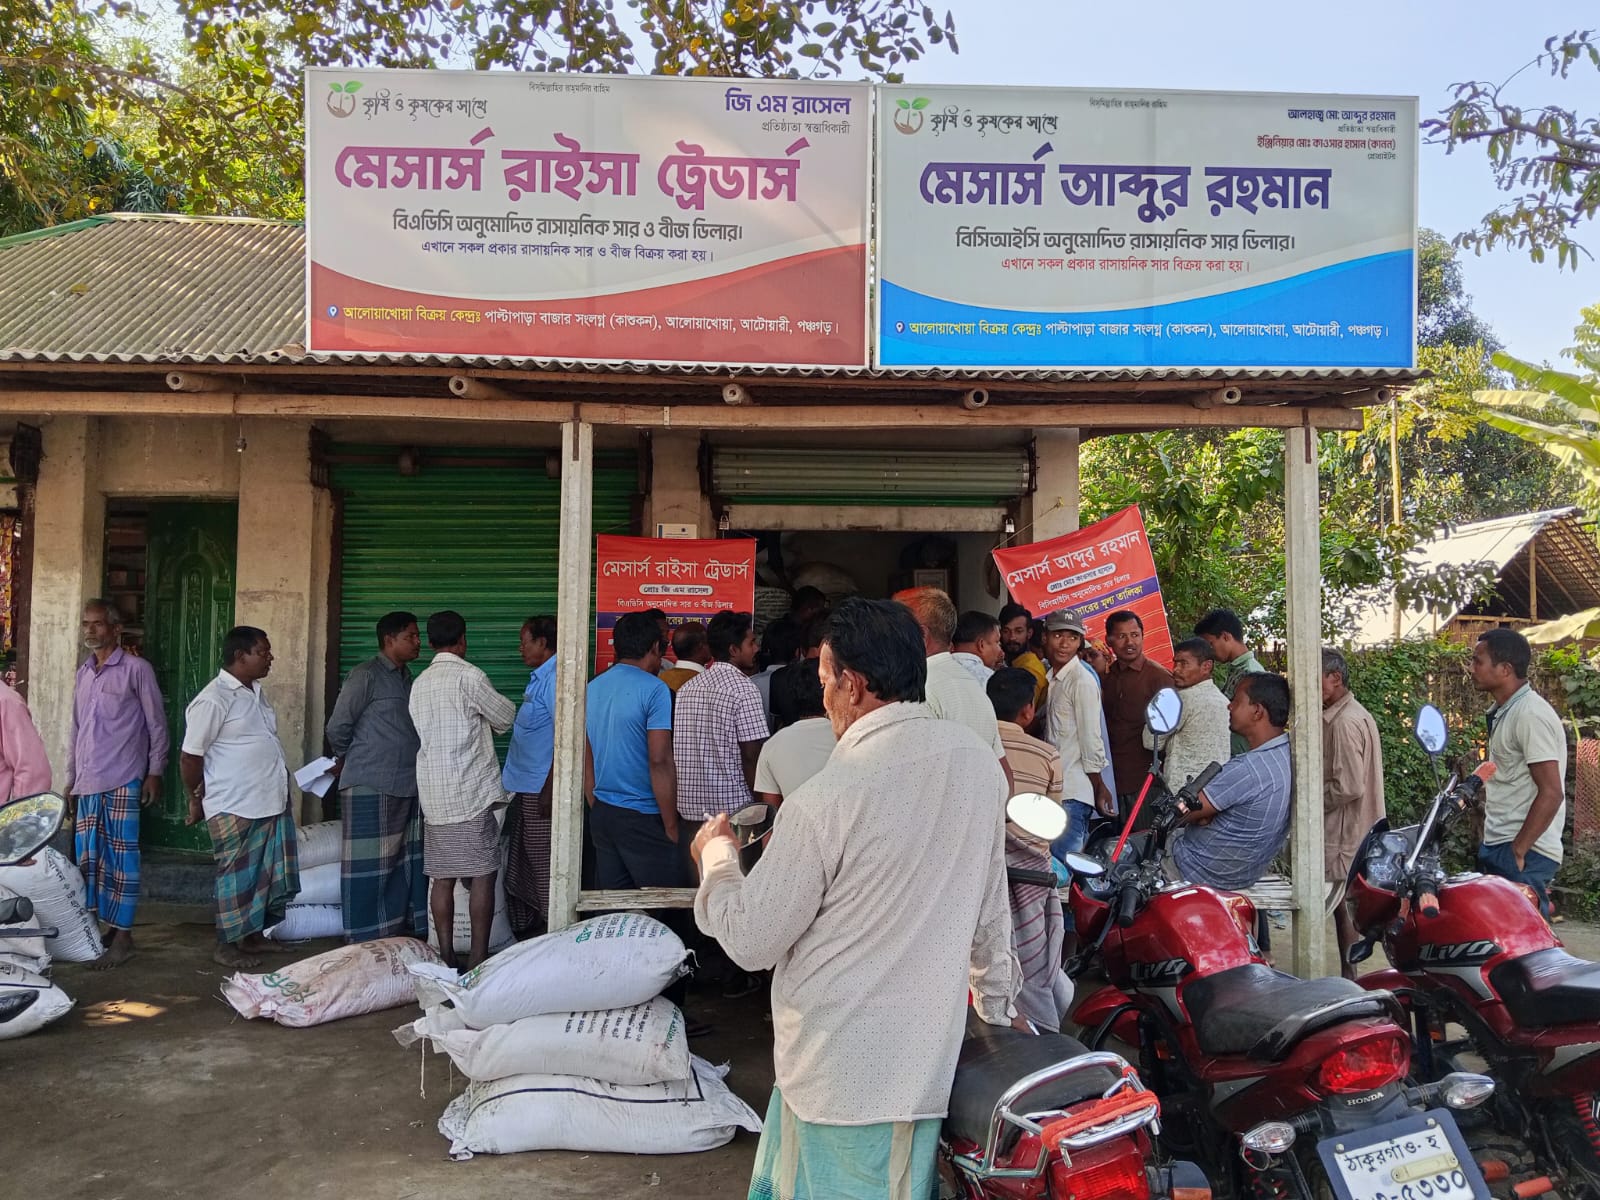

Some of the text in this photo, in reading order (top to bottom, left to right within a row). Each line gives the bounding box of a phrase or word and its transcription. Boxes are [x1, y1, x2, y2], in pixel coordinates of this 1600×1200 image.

[362, 88, 390, 120] কৃষি
[408, 98, 453, 121] কৃষকের
[456, 97, 488, 119] সাথে
[725, 87, 851, 115] জি এম রাসেল
[762, 118, 802, 132] প্রতিষ্ঠাতা
[930, 105, 958, 137] কৃষি
[976, 114, 1022, 138] কৃষকের
[1026, 114, 1058, 134] সাথে
[1342, 110, 1368, 124] আব্দুর
[1370, 111, 1396, 121] রহমান
[1312, 138, 1343, 150] কাওসার
[1344, 140, 1366, 150] হাসান
[335, 126, 811, 210] মেসার্স রাইসা ট্রেডার্স
[920, 142, 1332, 223] মেসার্স আব্দুর রহমান
[393, 208, 453, 231] বিএডিসি
[456, 211, 534, 239] অনুমোদিত
[536, 213, 610, 237] রাসায়নিক
[612, 220, 640, 239] সার
[643, 222, 654, 238] ও
[658, 216, 690, 240] বীজ
[422, 241, 454, 254] এখানে
[458, 242, 484, 255] সকল
[488, 243, 517, 256] প্রকার
[521, 242, 570, 257] রাসায়নিক
[574, 246, 594, 257] সার
[598, 246, 606, 257] ও
[610, 243, 632, 259] বীজ
[634, 244, 665, 260] বিক্রয়
[668, 248, 688, 260] করা
[956, 226, 1040, 248] বিসিআইসি
[1044, 227, 1126, 254] অনুমোদিত
[1130, 228, 1207, 251] রাসায়নিক
[1210, 234, 1239, 252] সার
[1002, 258, 1034, 270] এখানে
[1038, 258, 1064, 271] সকল
[1066, 258, 1096, 272] প্রকার
[1098, 256, 1148, 272] রাসায়নিক
[1151, 260, 1170, 271] সার
[1174, 256, 1202, 272] বিক্রয়
[1206, 260, 1225, 272] করা
[343, 306, 414, 322] আলোয়াখোয়া
[416, 304, 447, 322] বিক্রয়
[450, 310, 481, 324] কেন্দ্রঃ
[540, 311, 572, 326] বাজার
[909, 322, 976, 336] আলোয়াখোয়া
[978, 320, 1008, 336] বিক্রয়
[1012, 322, 1042, 336] কেন্দ্রঃ
[1098, 323, 1130, 336] বাজার
[603, 556, 751, 581] মেসার্স রাইসা ট্রেডার্স
[1006, 530, 1142, 588] মেসার্স আব্দুর রহমান
[1116, 585, 1143, 602] তালিকা
[1346, 1092, 1384, 1106] HONDA
[1426, 1134, 1441, 1150] হ
